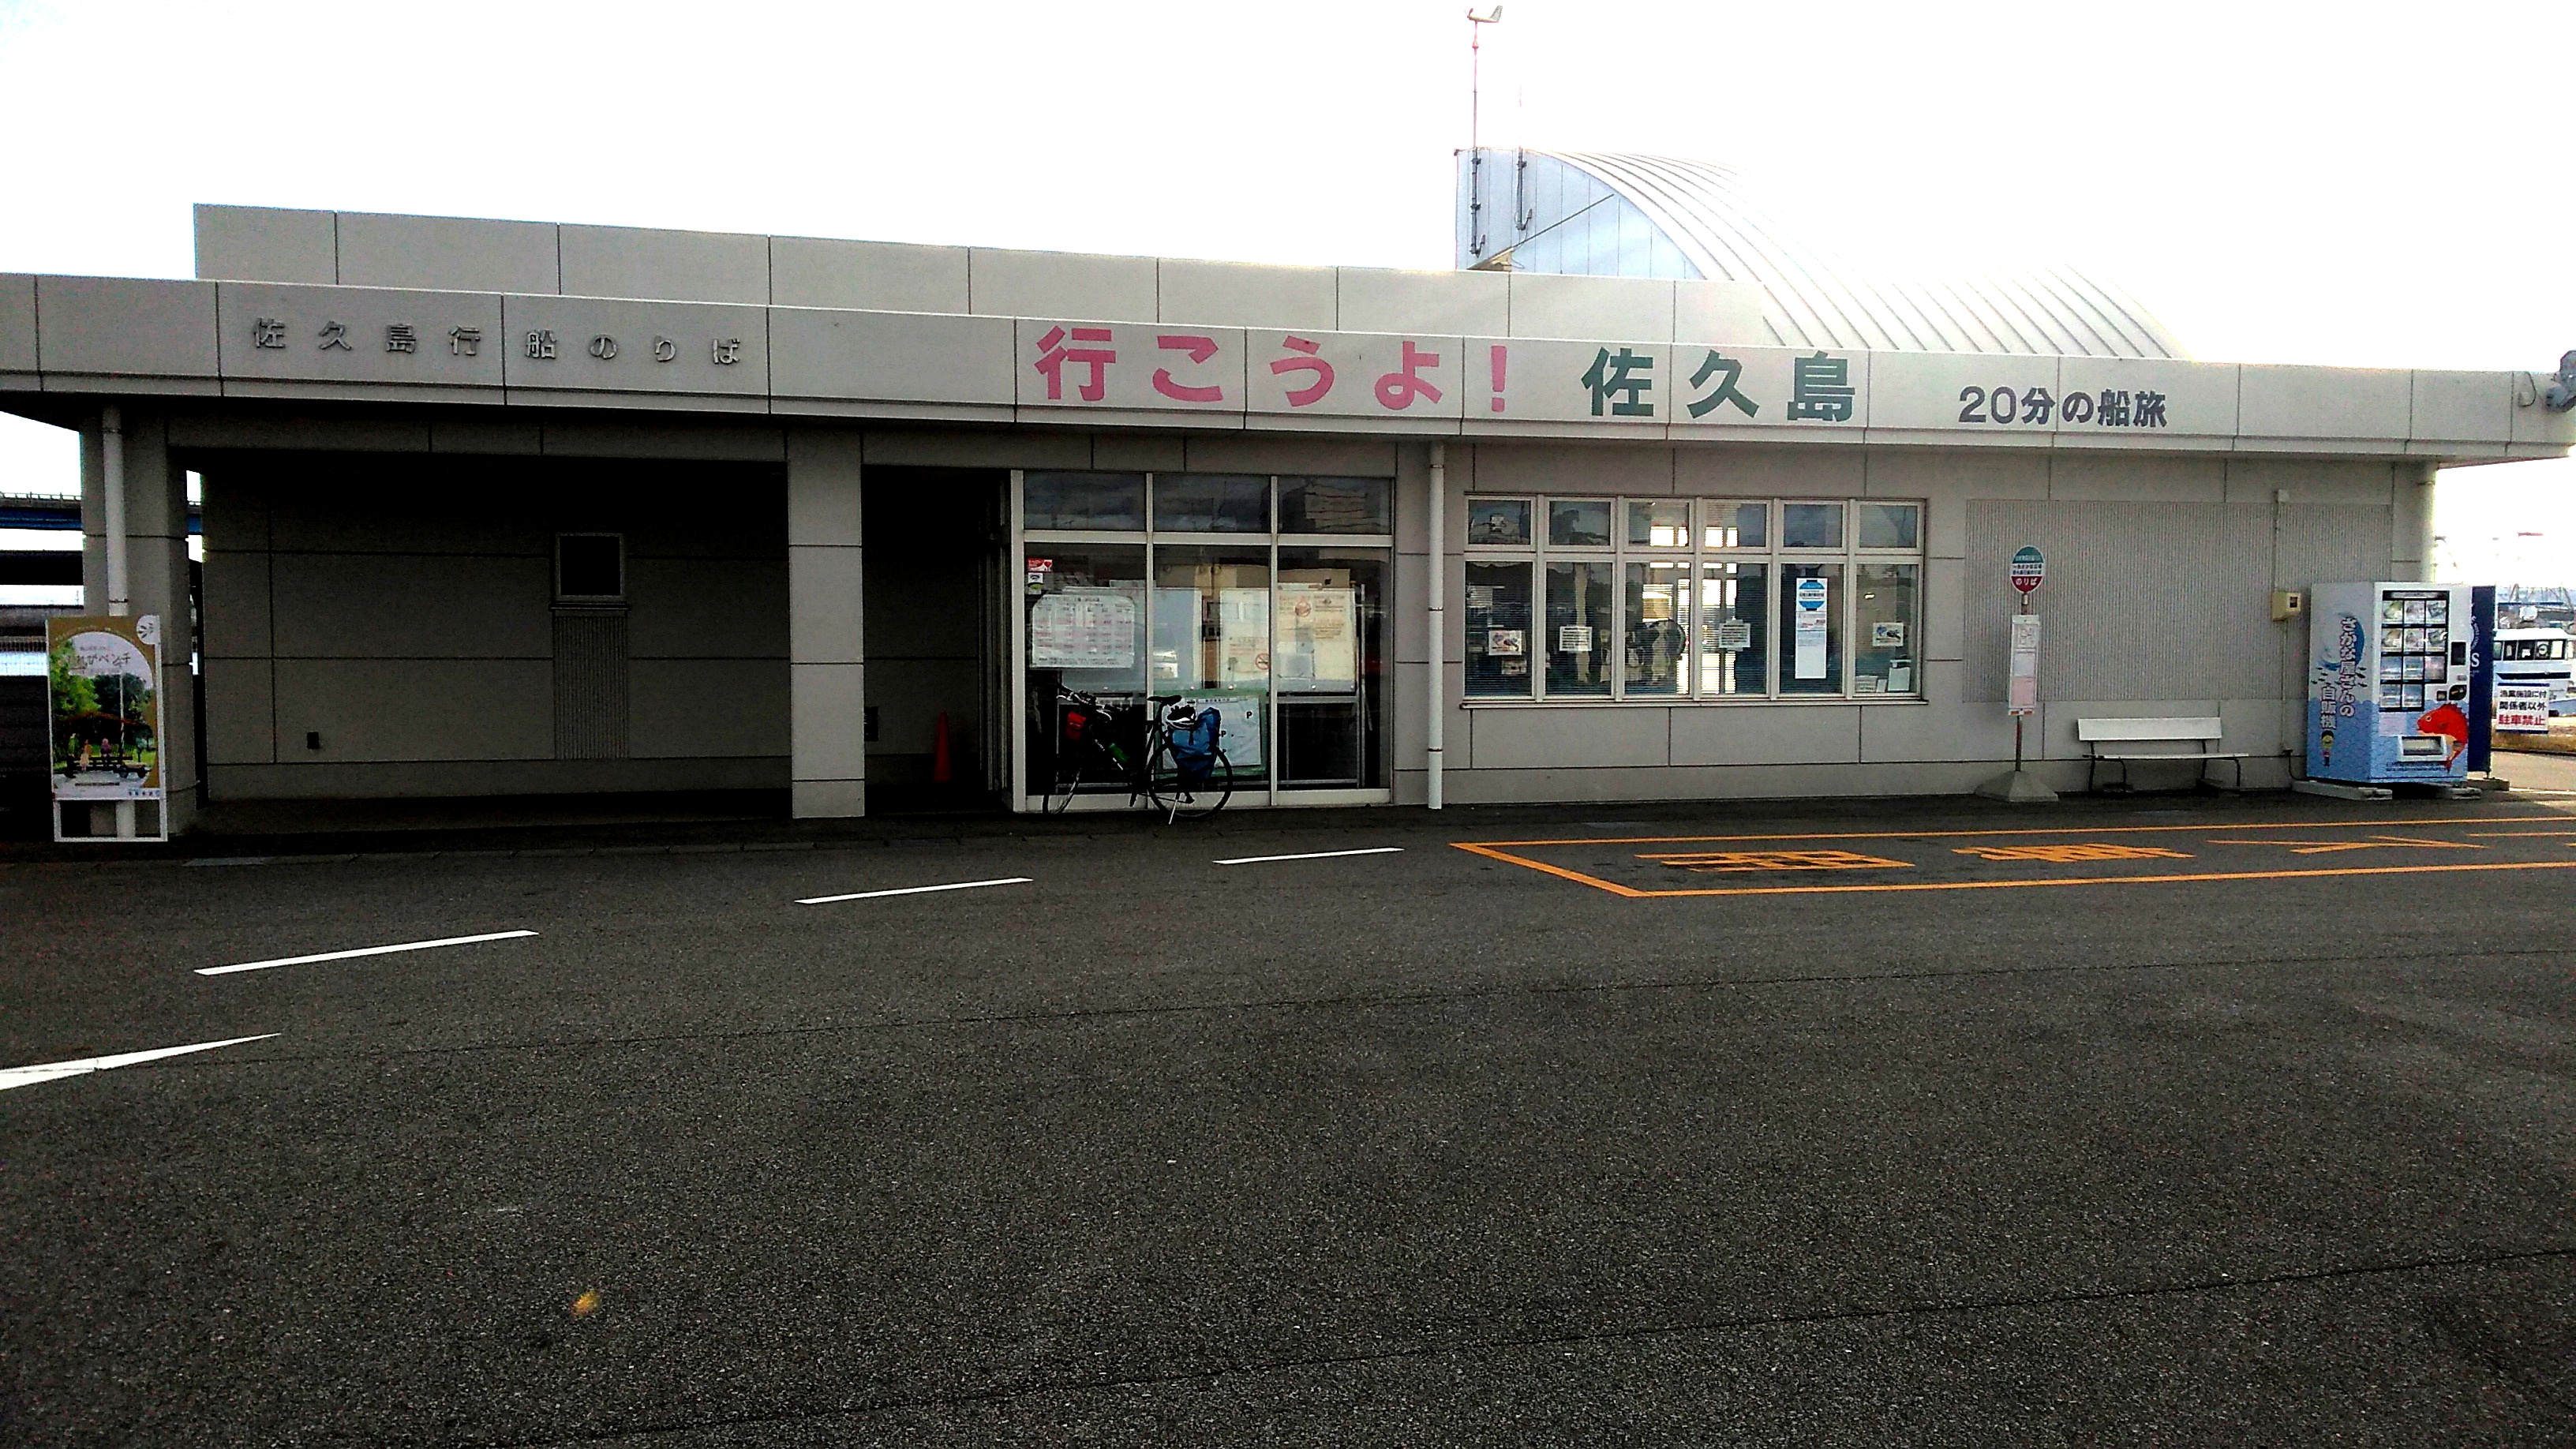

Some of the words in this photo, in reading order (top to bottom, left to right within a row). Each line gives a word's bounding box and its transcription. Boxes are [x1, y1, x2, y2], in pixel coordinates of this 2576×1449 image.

[253, 319, 740, 365] 佐久島行船のりば
[1580, 346, 1856, 422] 佐久島
[1958, 385, 2168, 428] 20分の船旅
[2339, 617, 2357, 717] さかな屋さんの
[2320, 685, 2337, 729] 自販機
[2498, 714, 2545, 725] 駐車禁止
[2499, 701, 2547, 710] 関係者以外
